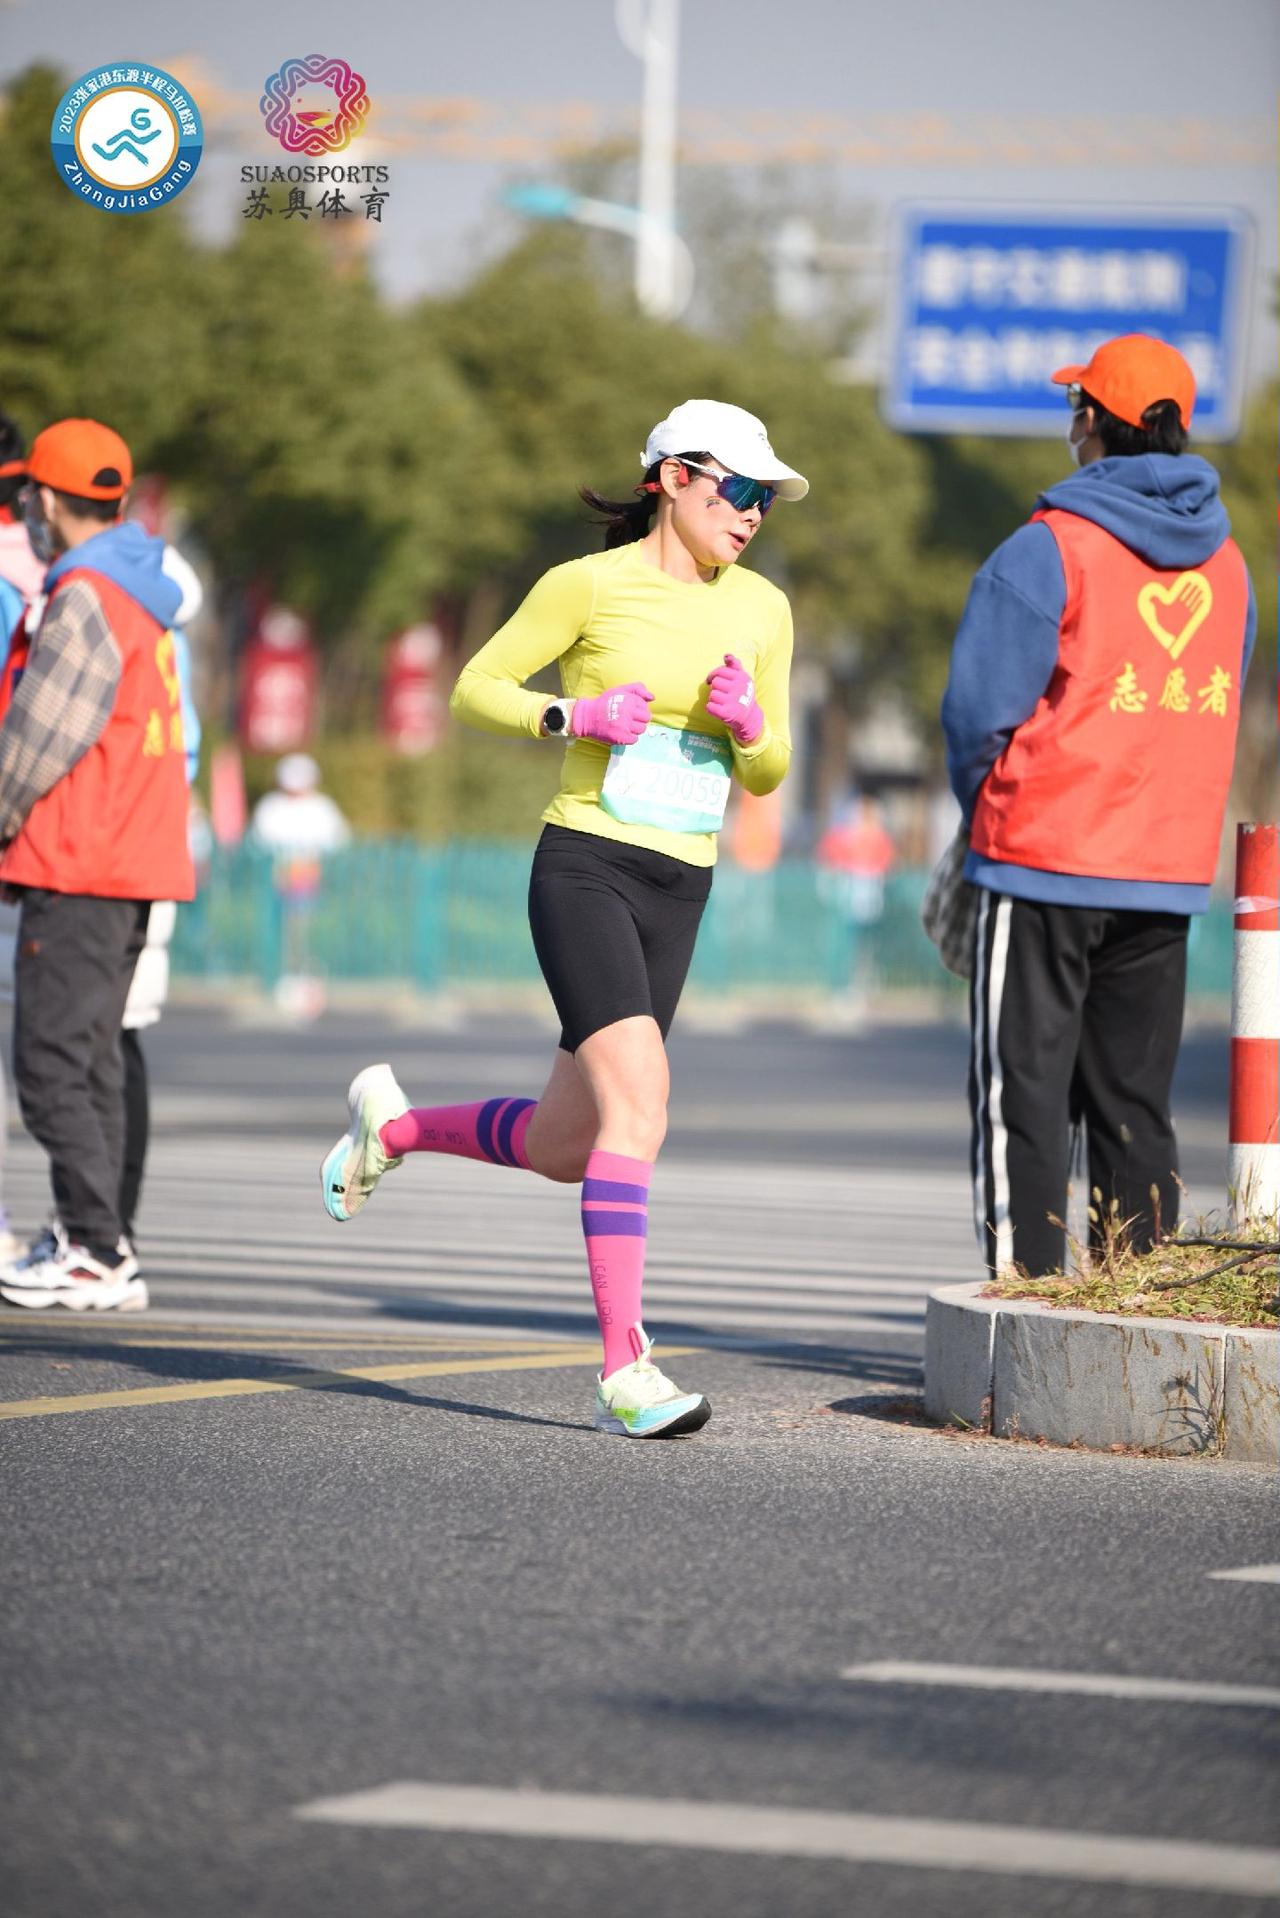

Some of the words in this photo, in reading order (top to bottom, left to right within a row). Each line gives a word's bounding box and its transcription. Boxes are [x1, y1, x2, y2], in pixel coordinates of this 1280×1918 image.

[1109, 662, 1232, 717] 志愿者
[593, 1265, 608, 1289] CAN
